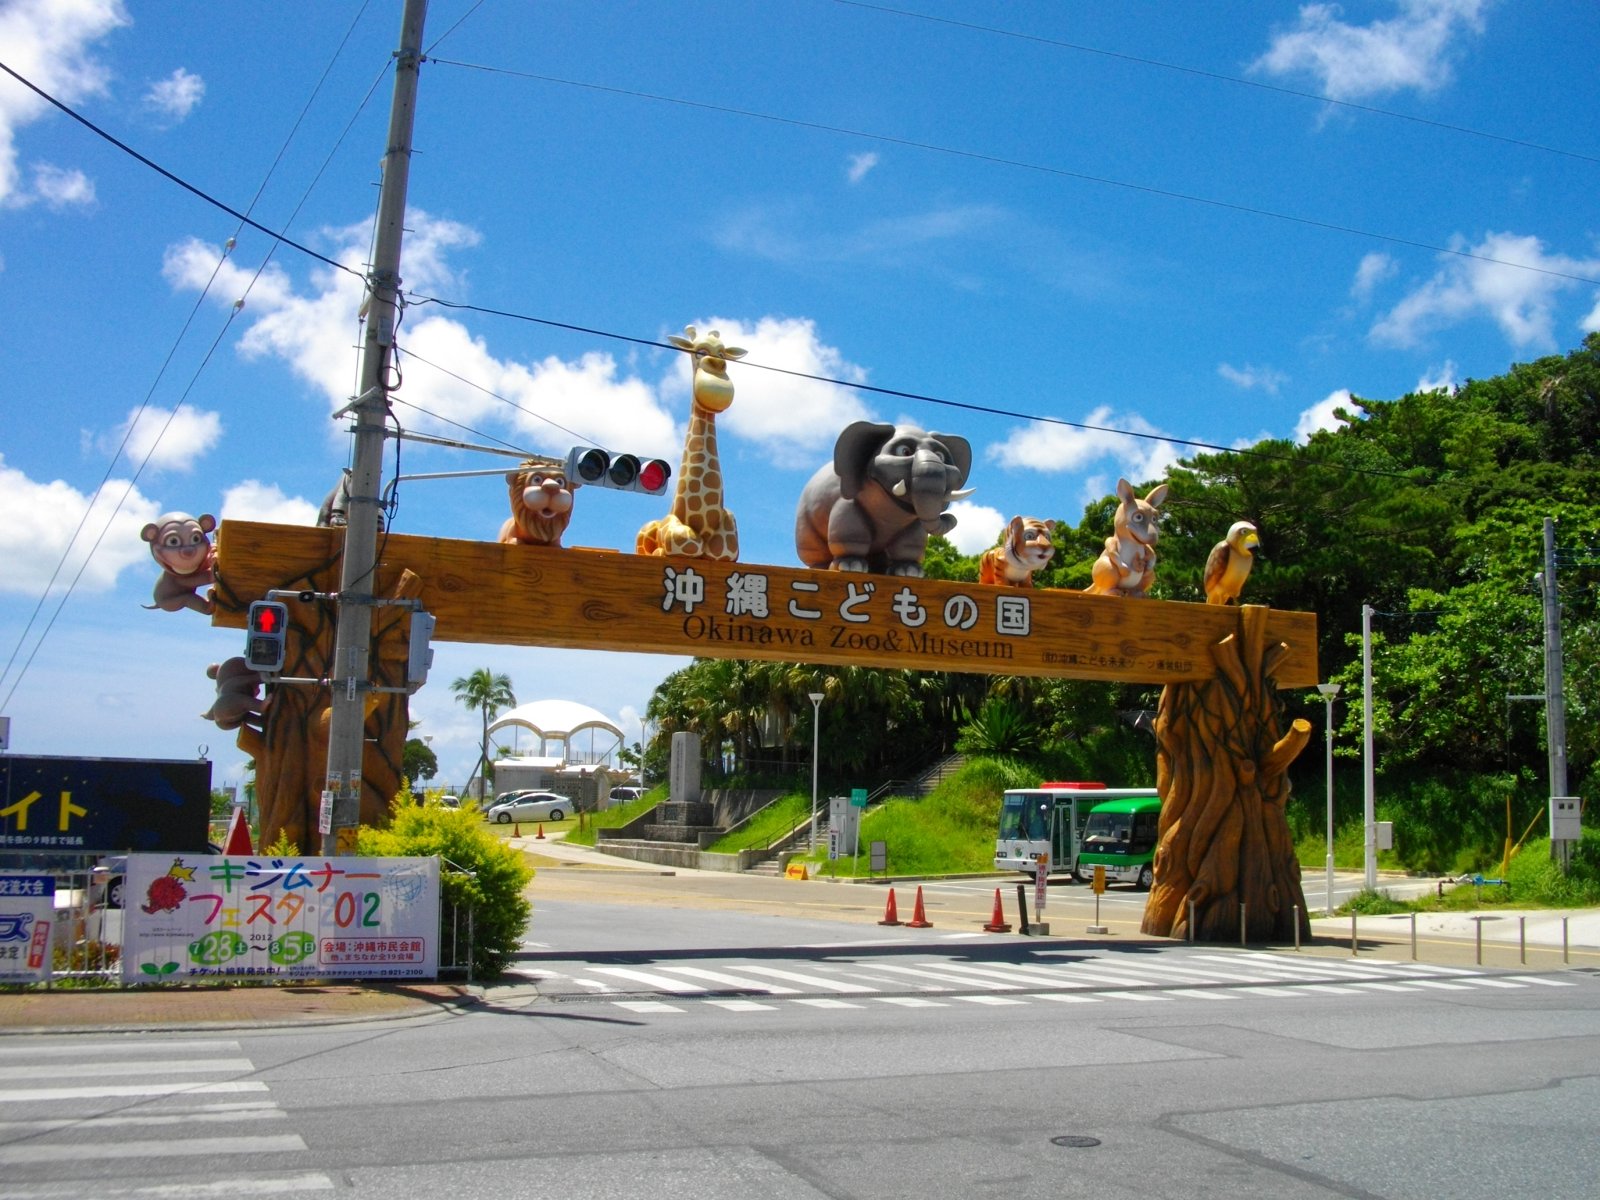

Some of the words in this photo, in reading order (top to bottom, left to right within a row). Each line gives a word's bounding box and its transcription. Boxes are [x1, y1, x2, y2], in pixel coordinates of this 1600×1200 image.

[662, 566, 1031, 637] 沖縄こどもの国
[683, 615, 815, 647] Okinawa
[209, 859, 382, 893] キジムナー
